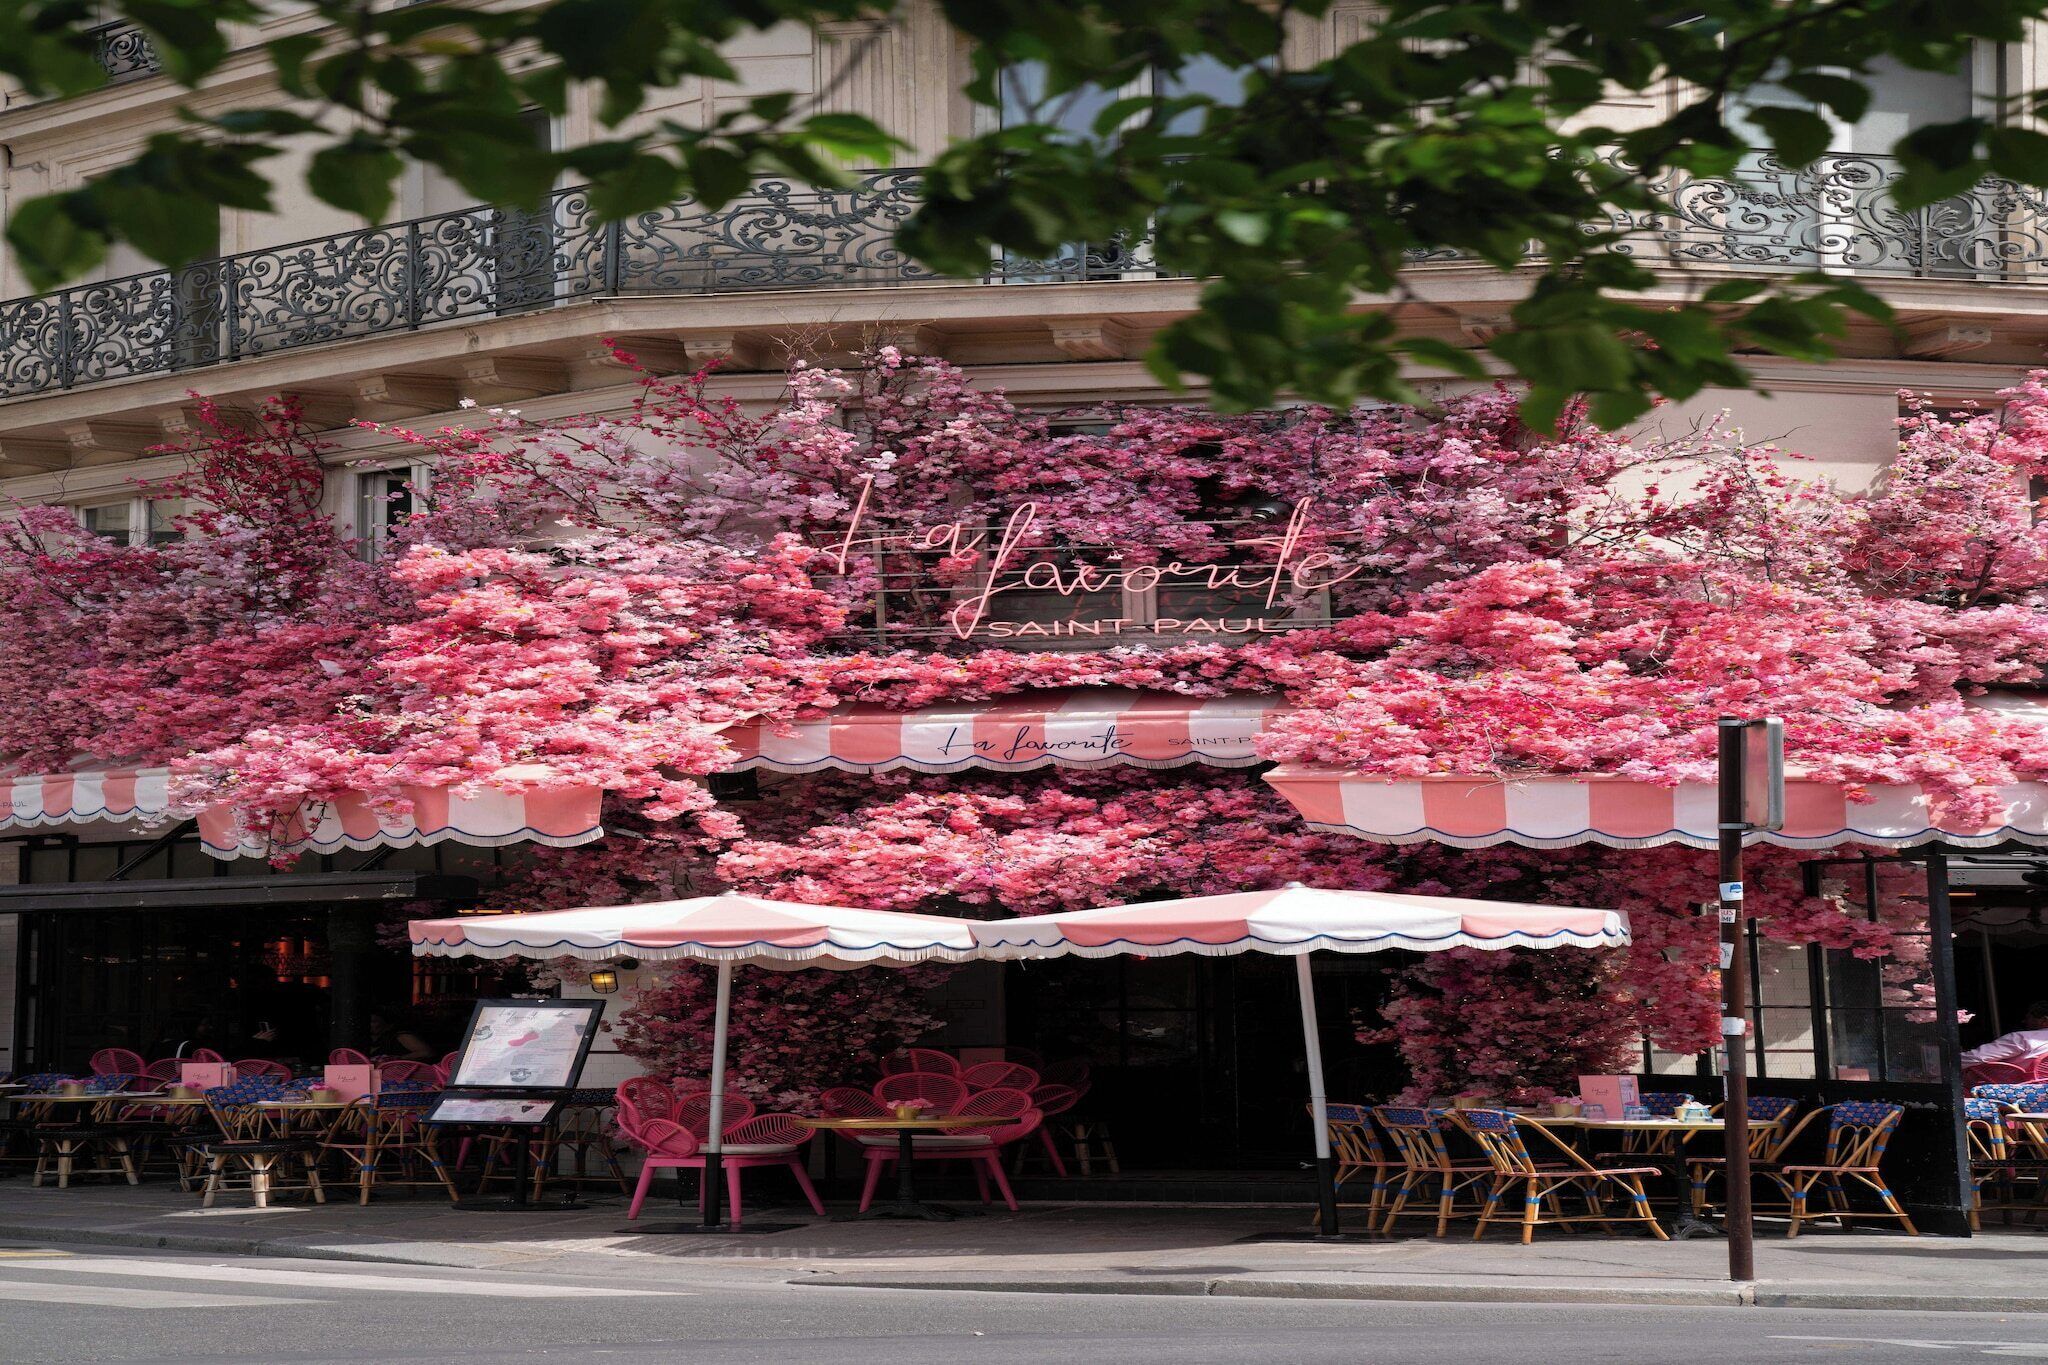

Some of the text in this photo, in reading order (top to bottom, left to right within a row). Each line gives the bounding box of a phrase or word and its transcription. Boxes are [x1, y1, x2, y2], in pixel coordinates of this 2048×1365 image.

[821, 475, 1363, 640] La favorite
[988, 617, 1287, 637] SAINT-PAUL
[937, 725, 1254, 760] La favorite SAINT-P
